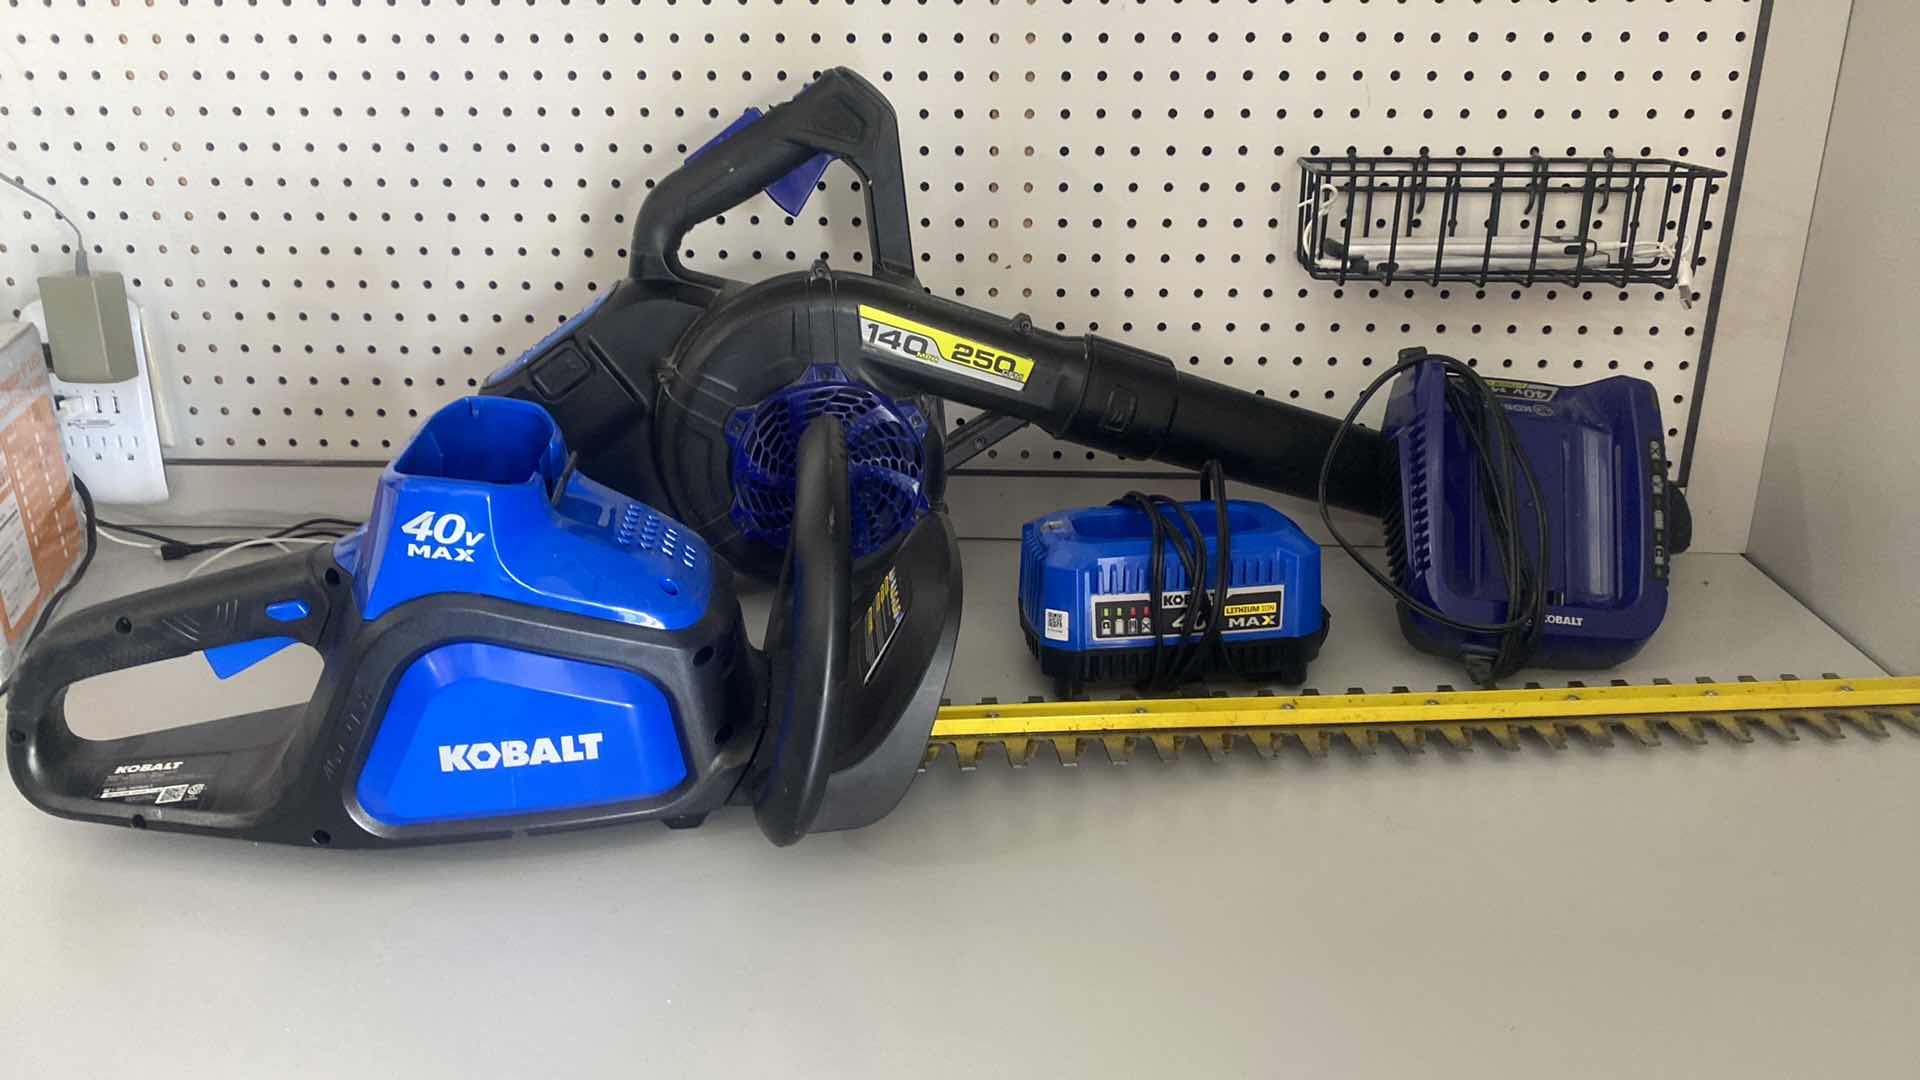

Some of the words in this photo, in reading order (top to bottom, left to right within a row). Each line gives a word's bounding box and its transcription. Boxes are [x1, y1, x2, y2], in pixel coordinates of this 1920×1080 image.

[867, 323, 929, 356] 140
[951, 343, 1017, 374] 250
[406, 543, 475, 563] MAX
[1226, 604, 1260, 615] LITHIUM
[1228, 614, 1277, 628] MAX
[1545, 614, 1584, 626] OBALT
[438, 732, 604, 773] KOBALT
[114, 761, 184, 774] KOBALT
